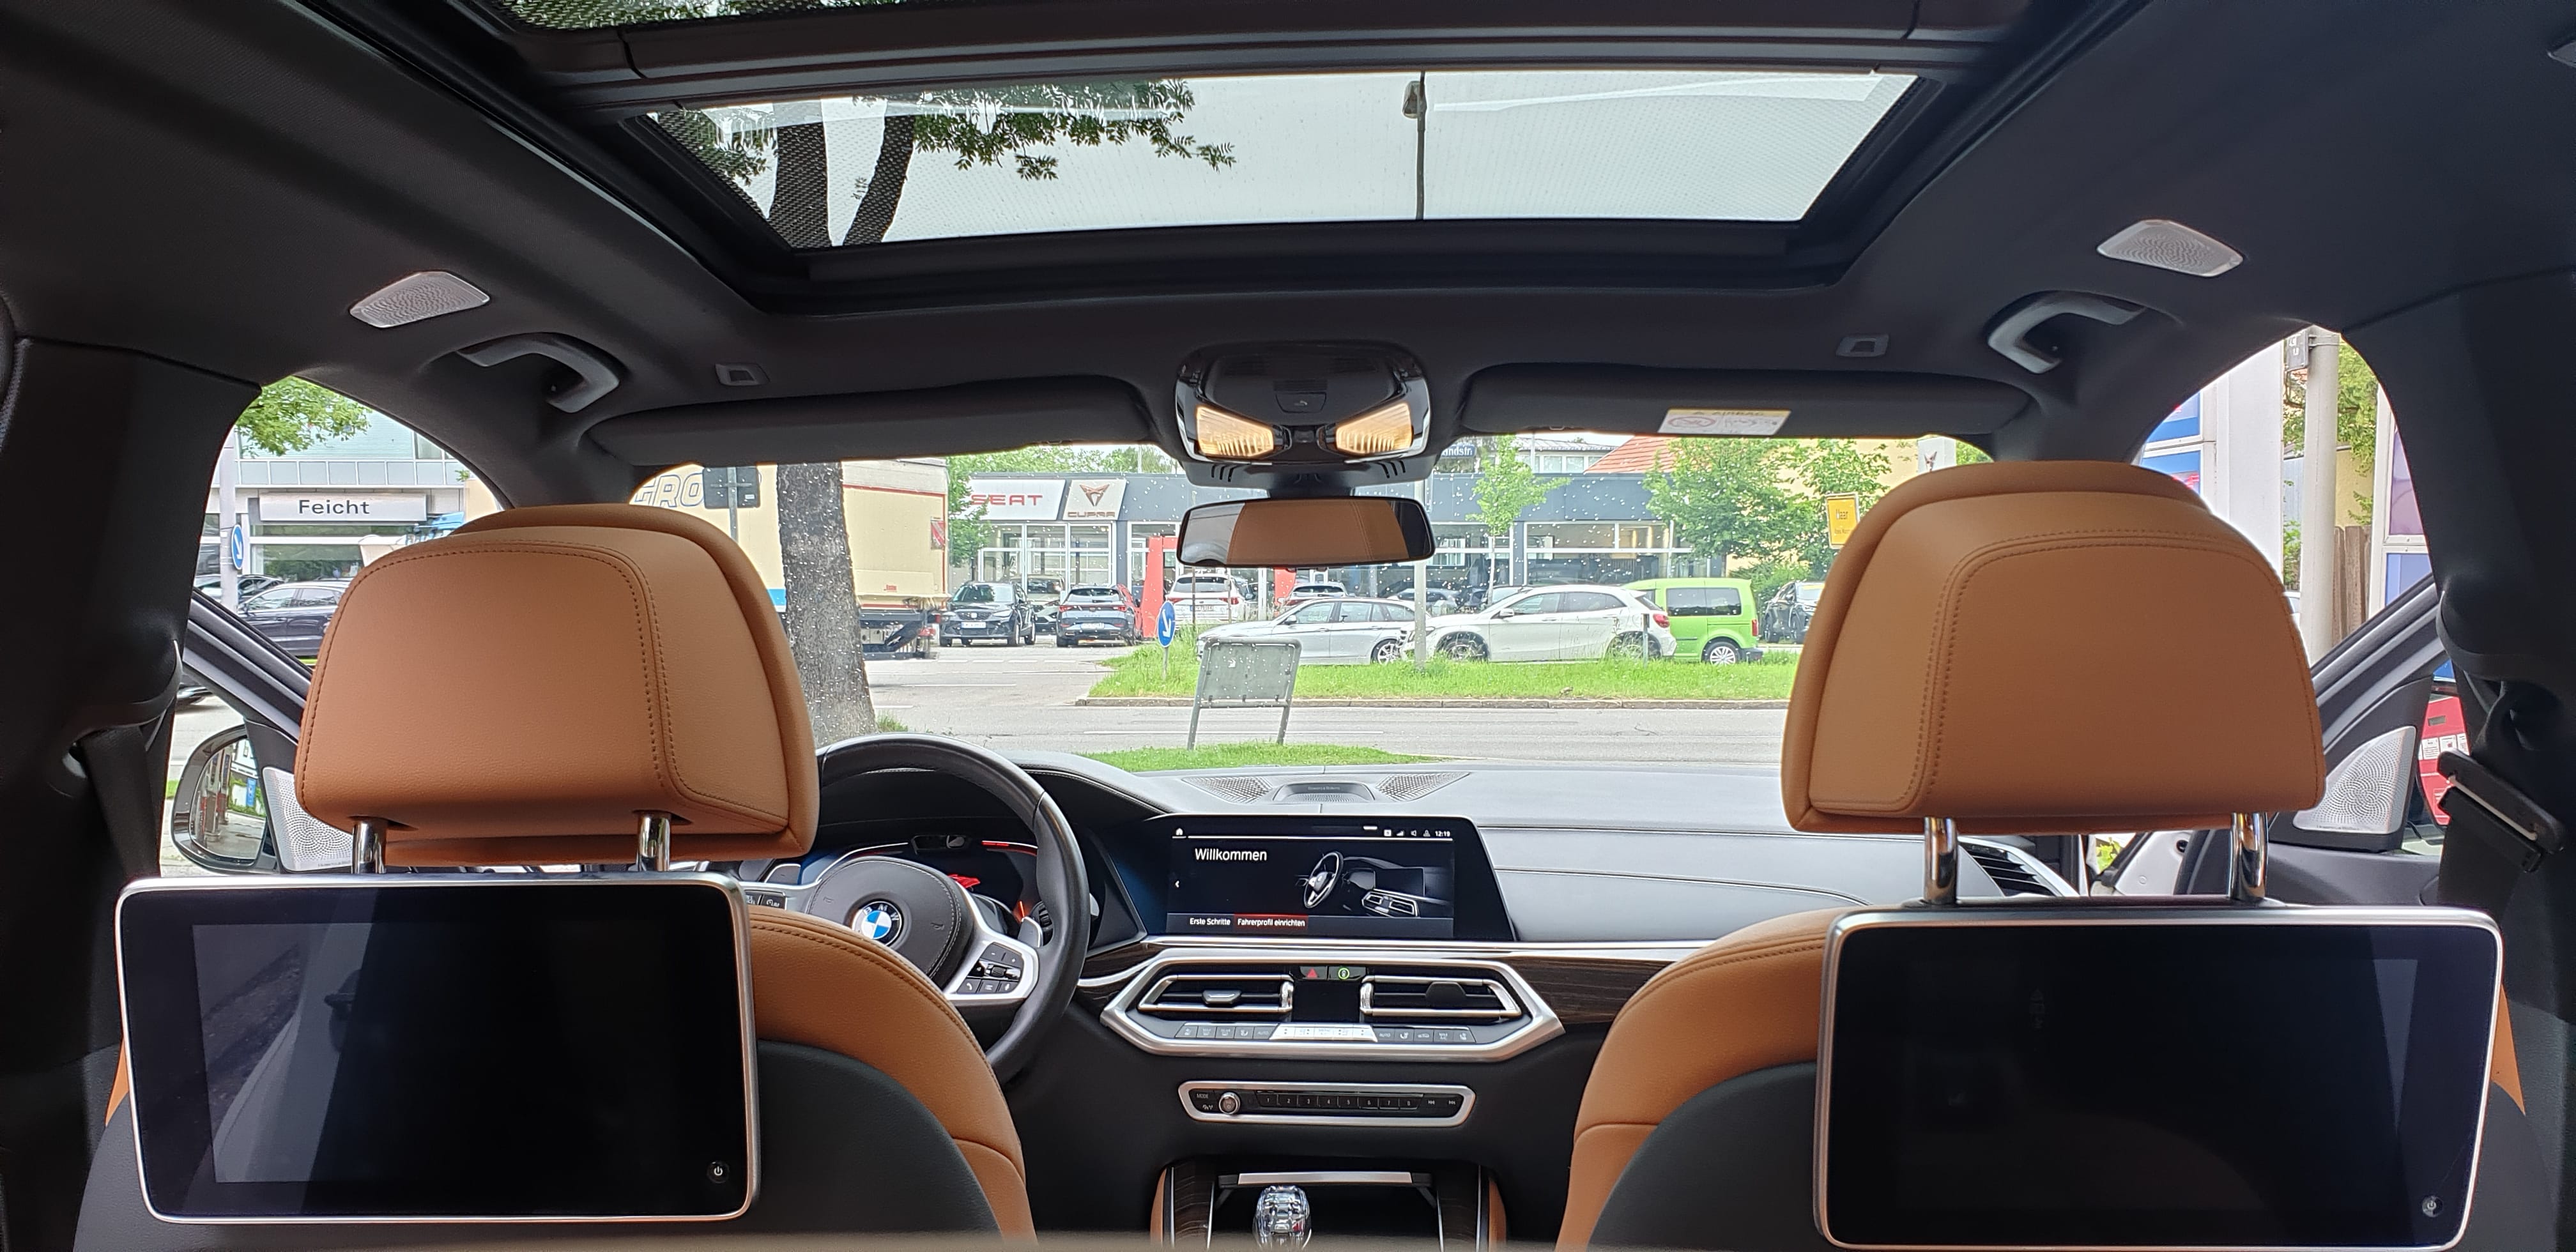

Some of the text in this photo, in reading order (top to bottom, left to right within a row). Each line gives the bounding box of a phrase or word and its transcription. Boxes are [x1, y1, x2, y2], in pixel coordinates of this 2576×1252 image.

[970, 494, 1043, 505] SEAT
[299, 499, 370, 514] Feicht
[1195, 848, 1267, 861] Willkommen
[862, 903, 900, 921] BMW
[1238, 919, 1273, 927] Fahrerprofil
